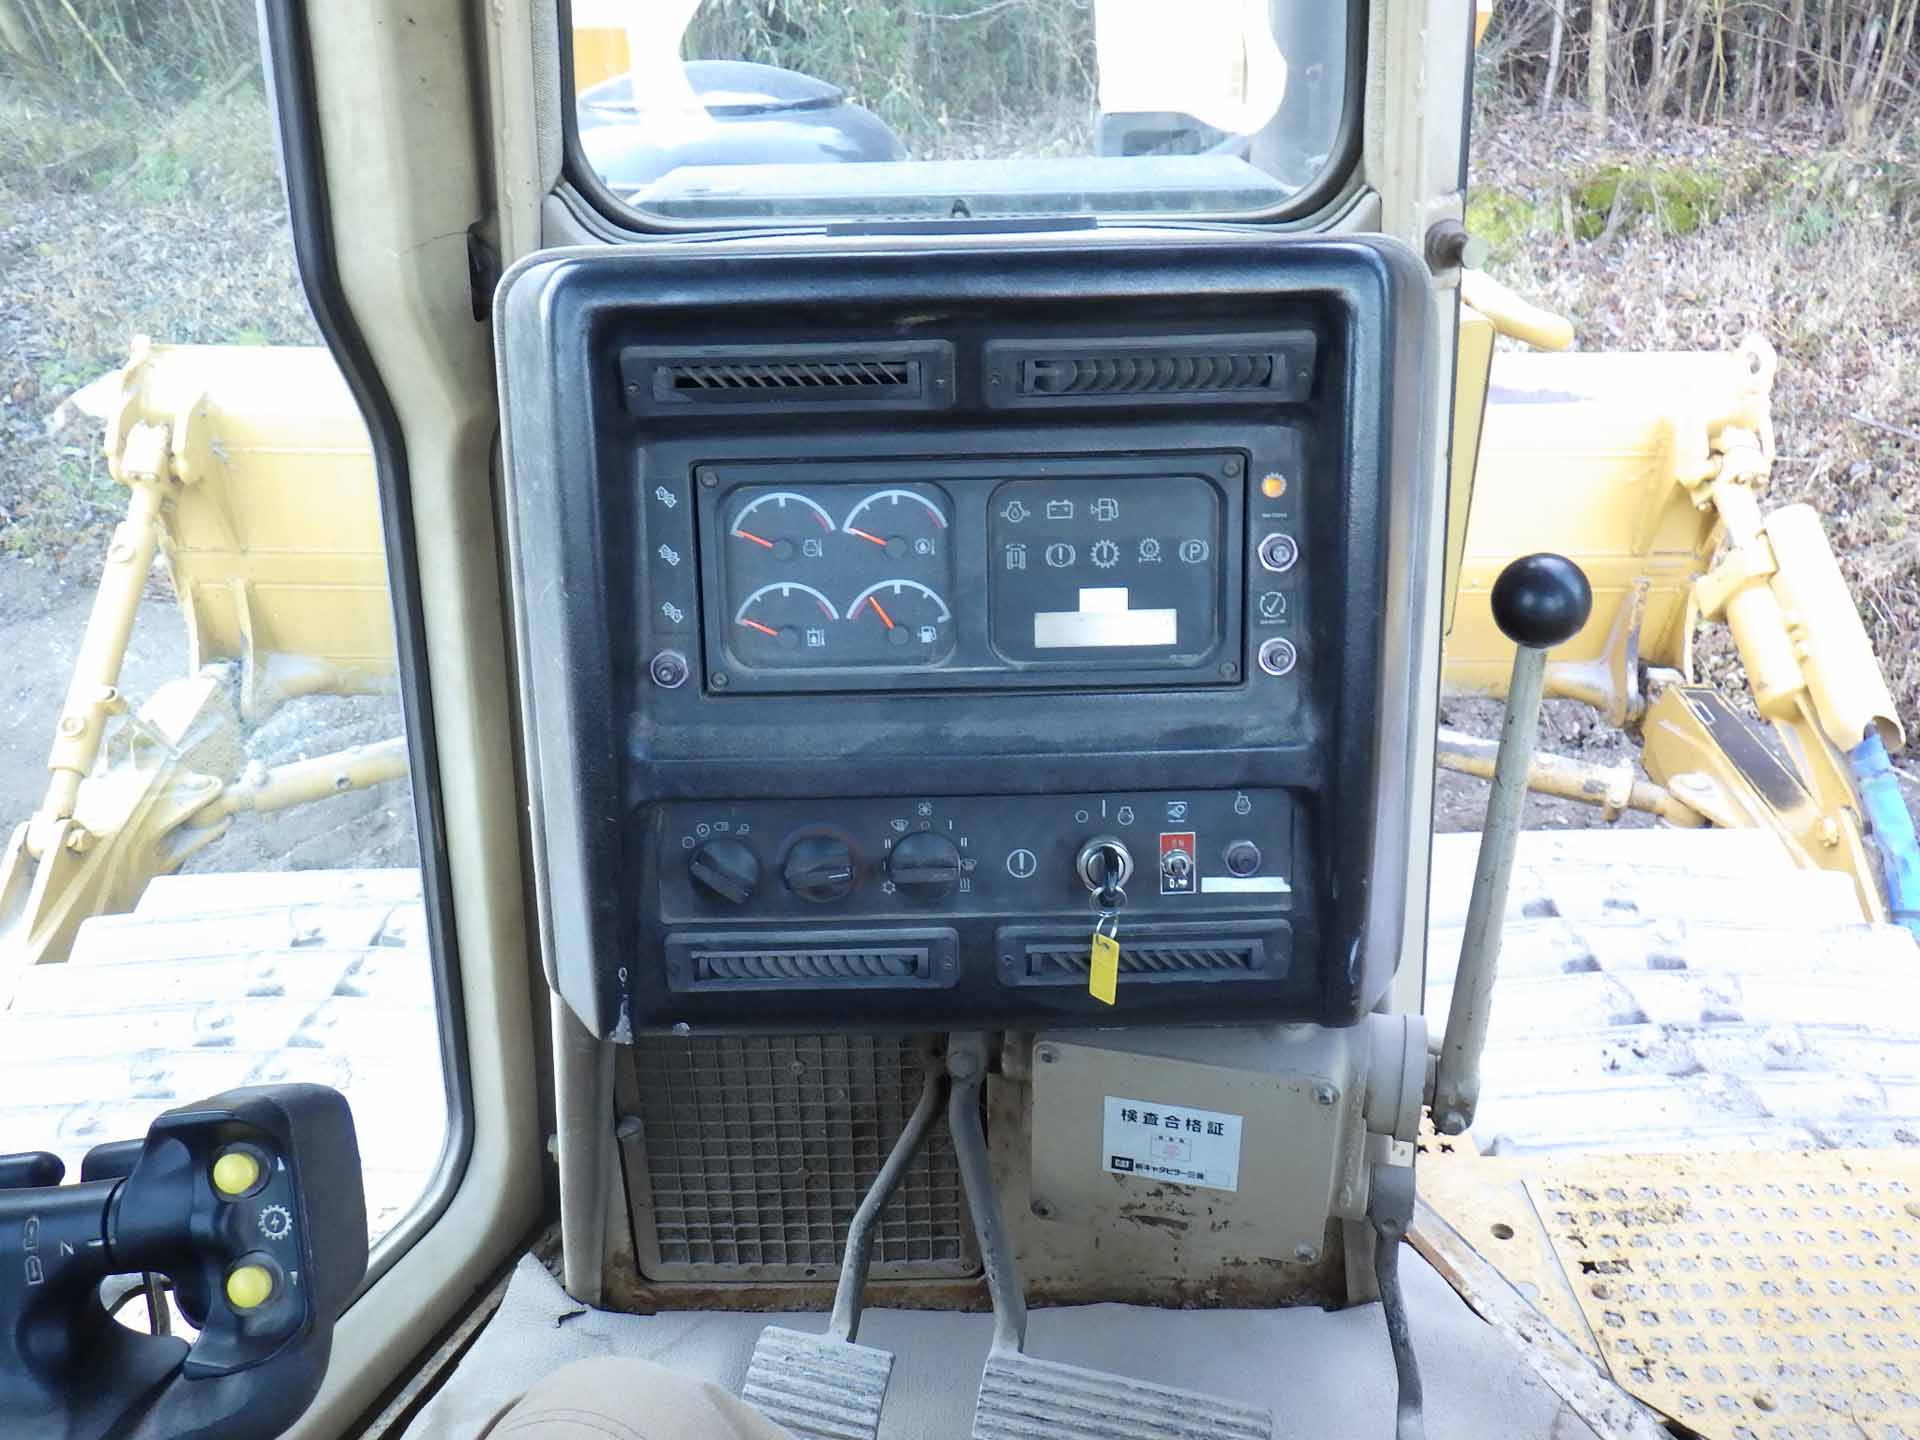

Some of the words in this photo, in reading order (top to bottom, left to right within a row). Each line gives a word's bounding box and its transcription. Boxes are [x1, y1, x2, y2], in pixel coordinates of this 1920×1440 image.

[1121, 1108, 1225, 1136] 検査合格証
